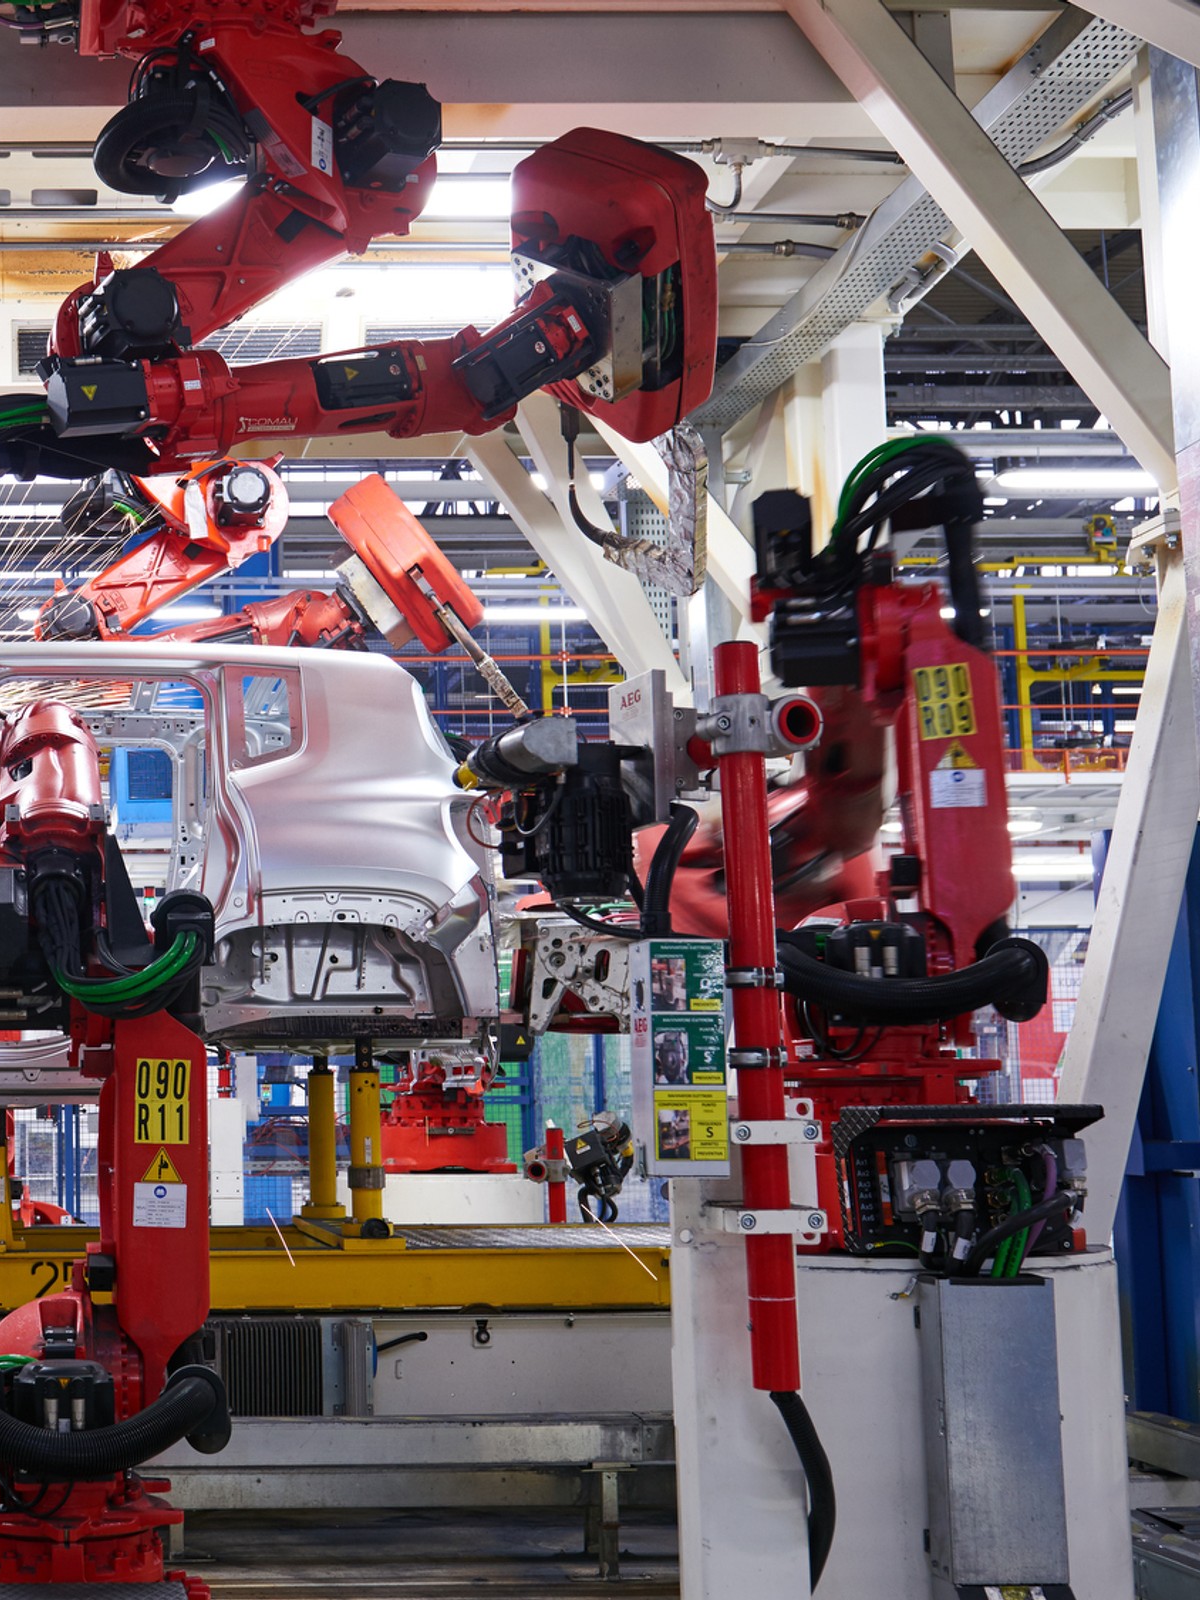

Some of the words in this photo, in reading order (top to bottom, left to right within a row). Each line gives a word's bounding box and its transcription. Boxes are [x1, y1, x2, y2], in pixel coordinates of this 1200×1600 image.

[620, 689, 642, 710] AEG
[916, 665, 970, 702] 090
[921, 701, 974, 738] R09
[137, 1061, 187, 1100] 090
[137, 1103, 184, 1141] R11
[706, 1126, 714, 1138] S
[31, 1261, 74, 1298] 2
